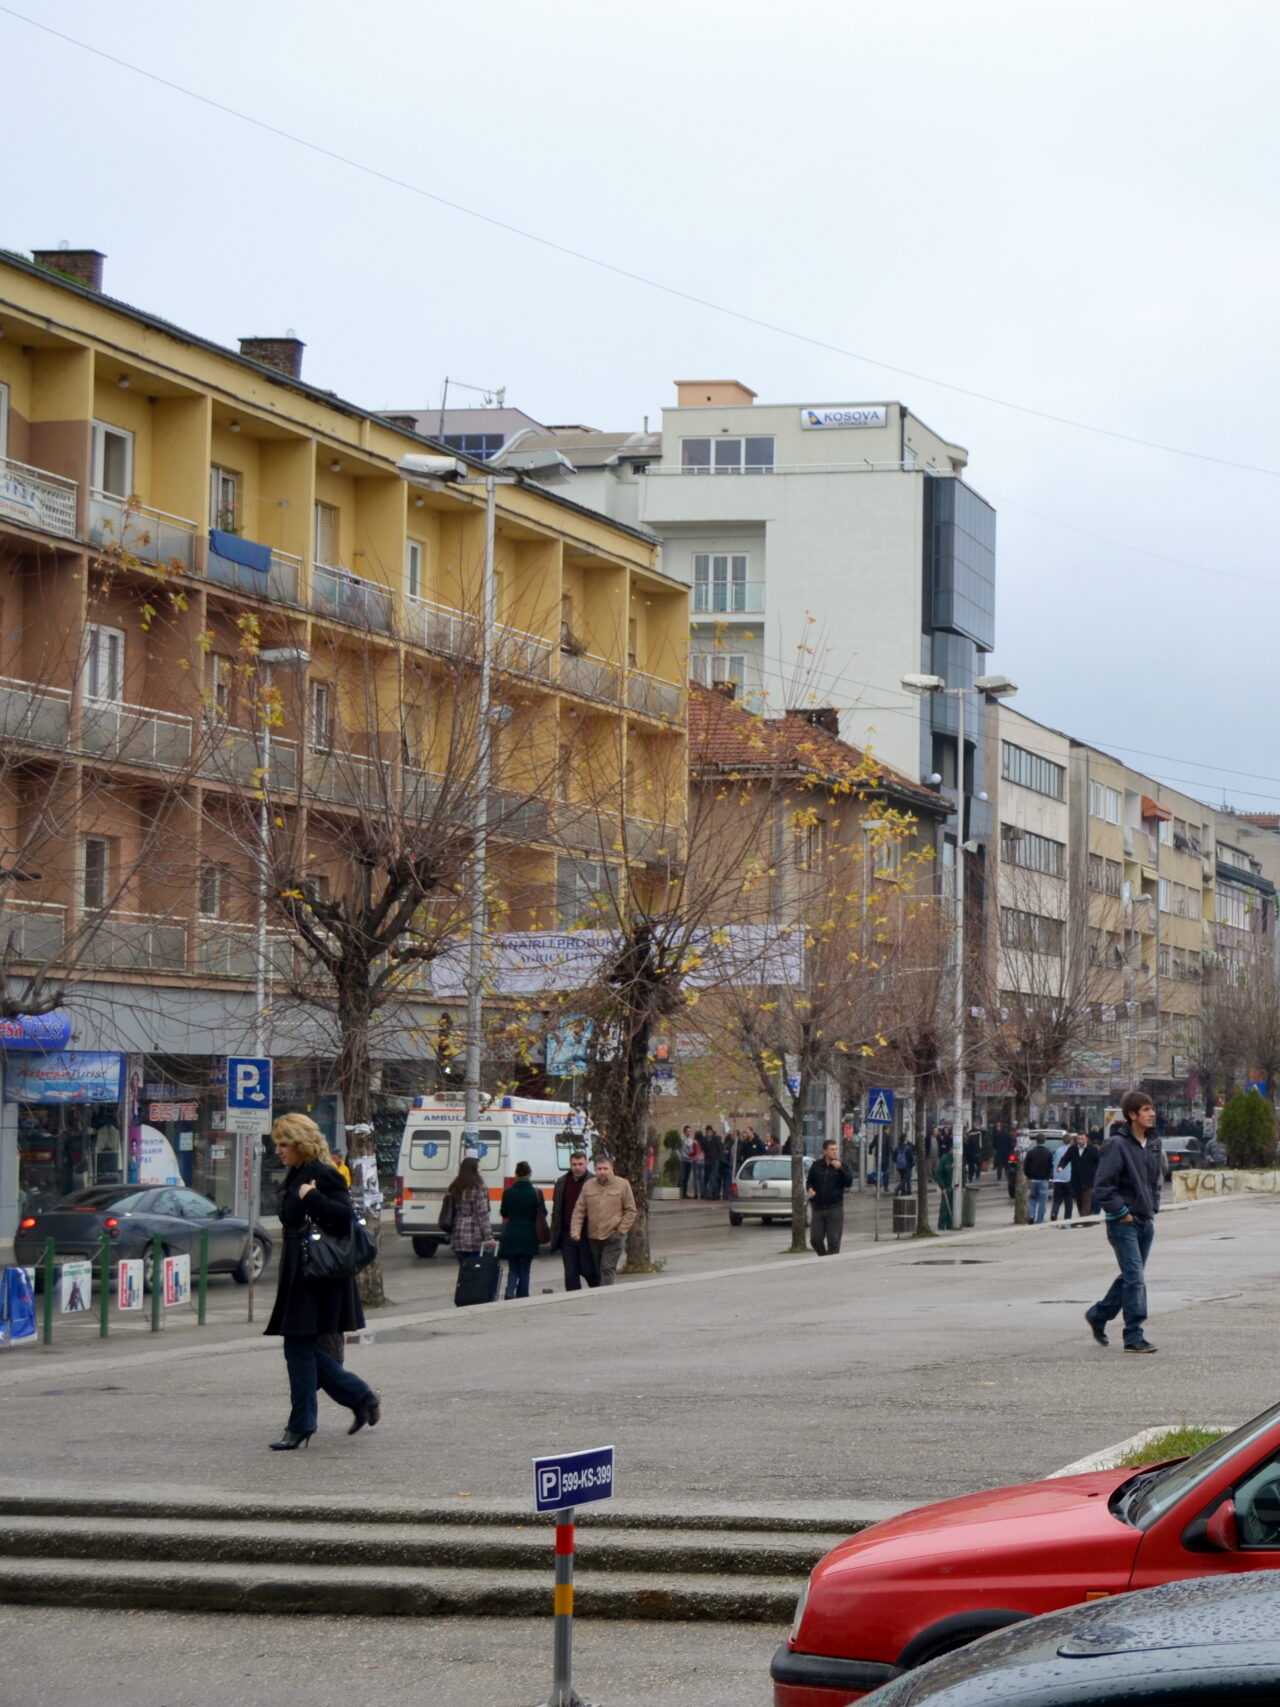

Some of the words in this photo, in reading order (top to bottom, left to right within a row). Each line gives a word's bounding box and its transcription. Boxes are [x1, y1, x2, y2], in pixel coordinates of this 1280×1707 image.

[824, 411, 880, 422] KOSOVA
[236, 1064, 260, 1100] P
[542, 1472, 557, 1497] P
[562, 1464, 612, 1493] 599-KS-399
